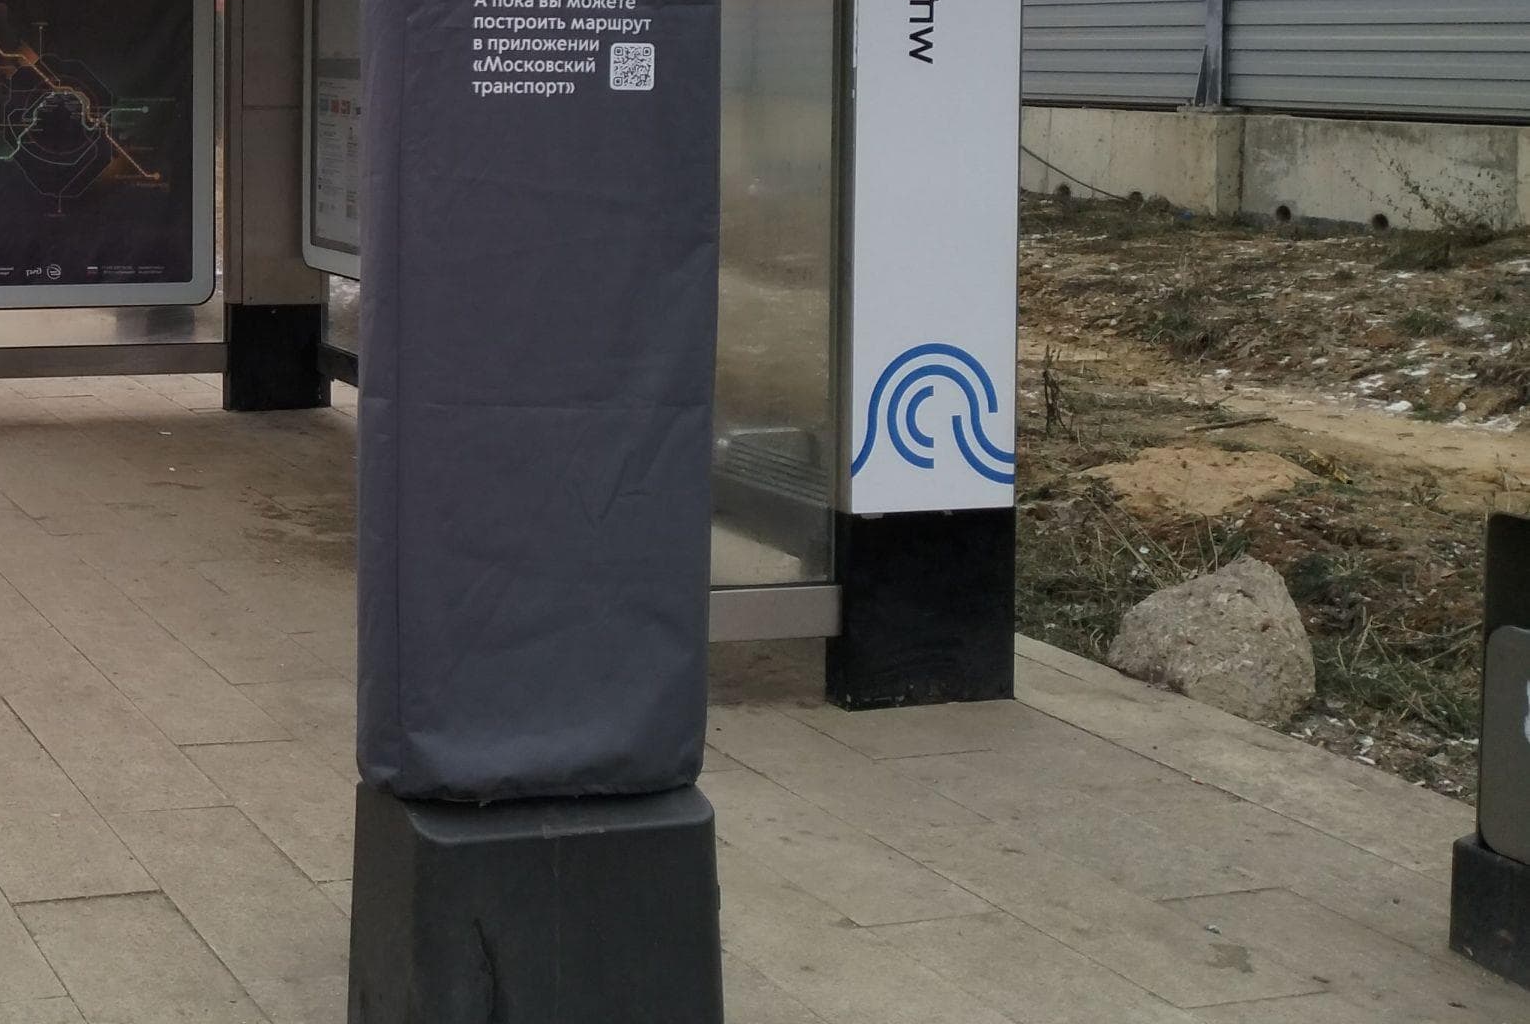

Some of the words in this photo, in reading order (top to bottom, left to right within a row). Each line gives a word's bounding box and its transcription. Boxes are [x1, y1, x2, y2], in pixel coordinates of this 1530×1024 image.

[473, 16, 566, 33] построить
[571, 17, 651, 35] маршрут
[473, 38, 483, 51] в
[487, 38, 600, 55] приложении
[473, 55, 596, 73] «Московский
[472, 81, 576, 98] транспорт»
